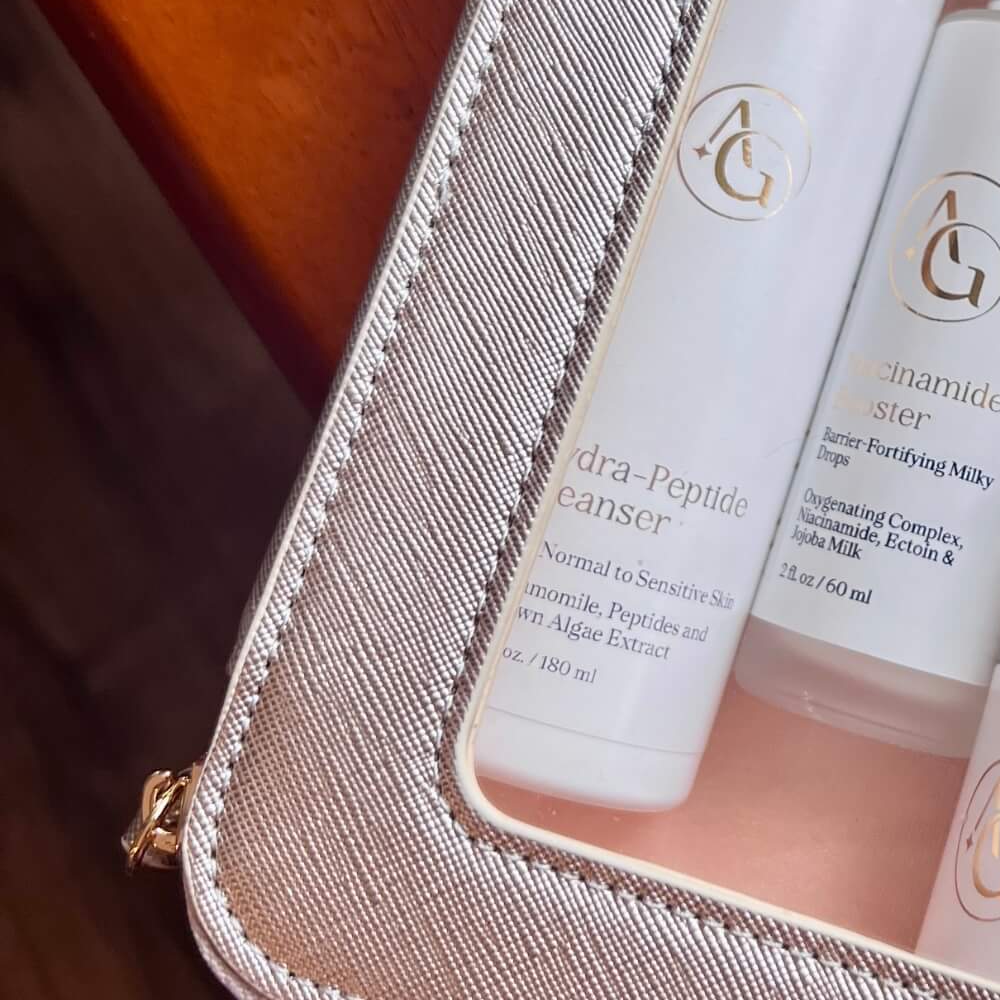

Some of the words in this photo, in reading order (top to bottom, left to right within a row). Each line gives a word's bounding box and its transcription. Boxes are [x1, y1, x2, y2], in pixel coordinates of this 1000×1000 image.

[570, 443, 750, 519] dra-Peptide
[816, 444, 851, 469] Drops
[822, 426, 947, 478] Barrier-Fortifying
[947, 461, 995, 491] Milky
[791, 524, 826, 549] Jojoba
[826, 535, 863, 561] Milk
[797, 505, 881, 547] Niacinamide,
[884, 531, 939, 562] Ectoin
[941, 550, 956, 567] &
[803, 487, 887, 529] Oxygenating
[887, 512, 964, 551] Complex,
[538, 540, 612, 578] Normal
[614, 565, 634, 584] to
[635, 569, 709, 605] Sensitive
[709, 588, 737, 611] Skin
[779, 561, 789, 578] 2
[799, 572, 816, 588] oz
[815, 575, 827, 590] /
[826, 577, 849, 598] 60
[848, 588, 873, 605] ml
[546, 612, 604, 642] Algae
[605, 627, 671, 661] Extract
[607, 600, 680, 637] Peptides
[681, 623, 709, 643] and
[539, 654, 572, 677] 180
[573, 666, 598, 685] ml
